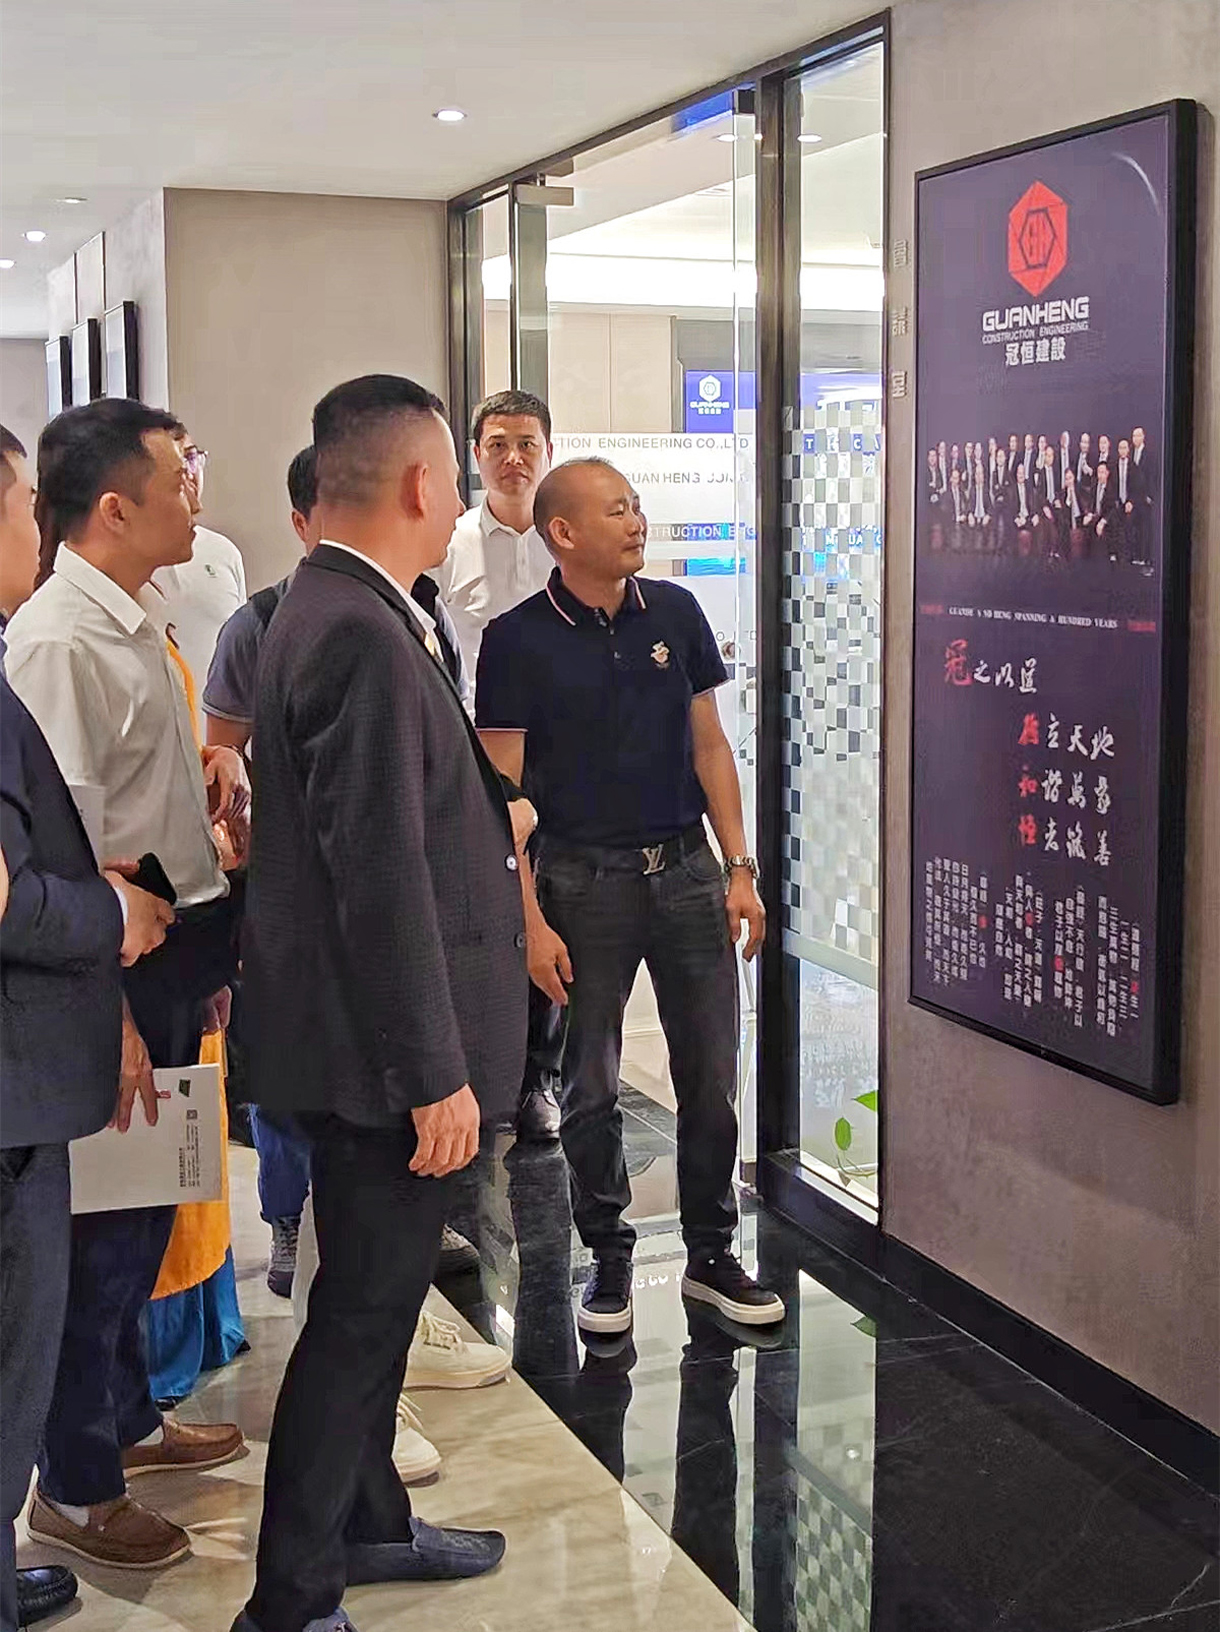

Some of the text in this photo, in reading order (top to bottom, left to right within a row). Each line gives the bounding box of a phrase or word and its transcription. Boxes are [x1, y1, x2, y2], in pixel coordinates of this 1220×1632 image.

[982, 296, 1090, 332] GUANHENG
[982, 320, 1089, 345] CONSTRUCTION ENGINEERING
[599, 437, 692, 449] ENGINEERING
